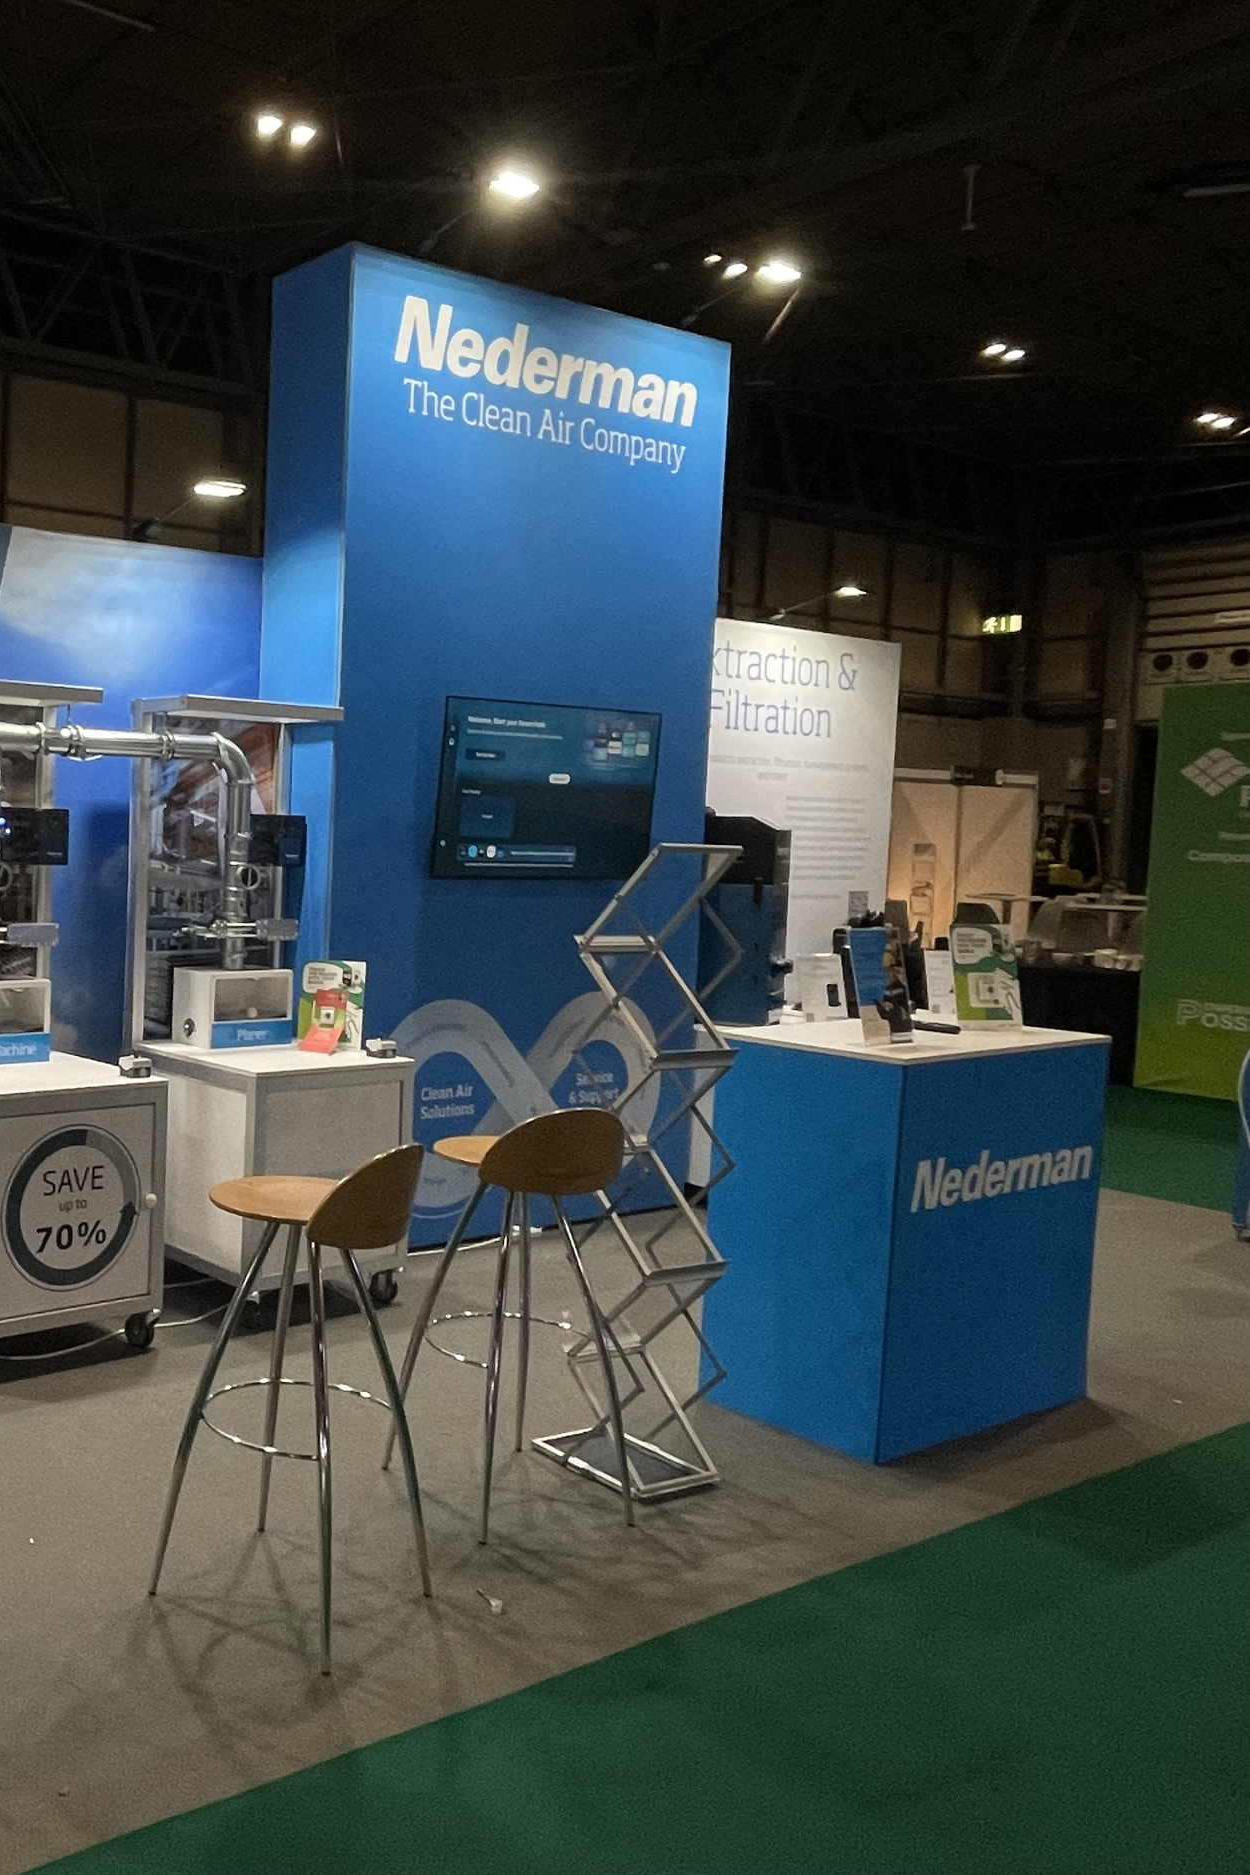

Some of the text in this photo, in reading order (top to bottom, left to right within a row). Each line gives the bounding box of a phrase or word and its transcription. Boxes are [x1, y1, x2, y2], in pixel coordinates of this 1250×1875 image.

[394, 295, 698, 427] Nederman
[403, 378, 687, 474] The Clean Air Company
[711, 641, 857, 691] xtraction &
[421, 1083, 474, 1101] Clean Air
[420, 1103, 475, 1120] Solutions
[42, 1165, 104, 1196] SAVE
[910, 1144, 1093, 1213] Nederman
[59, 1197, 87, 1214] up to
[36, 1220, 106, 1253] 70%
